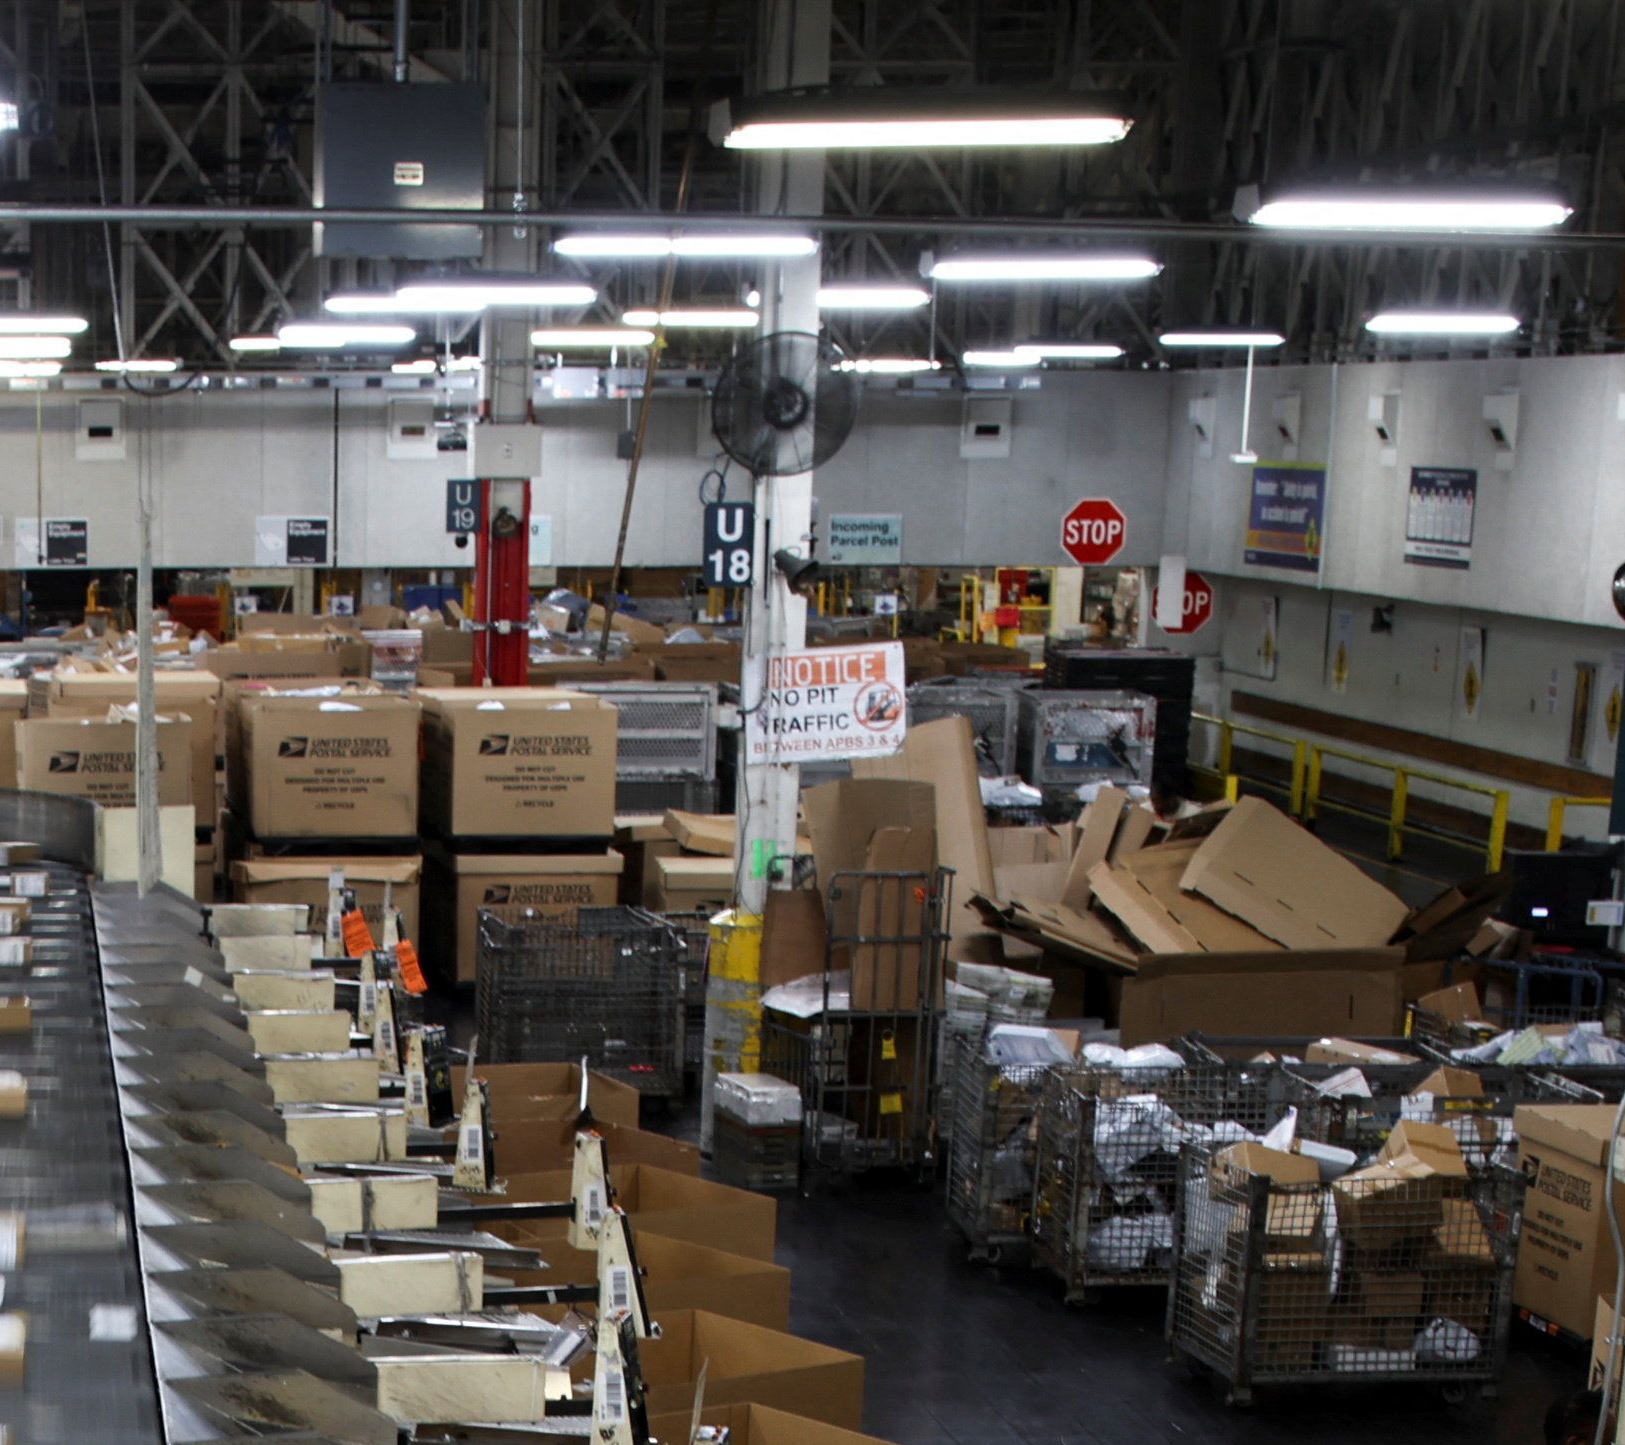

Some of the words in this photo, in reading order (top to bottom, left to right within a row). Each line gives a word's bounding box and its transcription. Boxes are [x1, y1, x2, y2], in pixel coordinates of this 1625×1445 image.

[456, 484, 471, 504] U
[452, 509, 476, 529] 19
[716, 508, 744, 542] U
[830, 521, 890, 535] Incoming
[830, 536, 869, 547] Parcel
[871, 535, 899, 547] Post
[1065, 519, 1122, 545] STOP
[708, 549, 750, 582] 18
[772, 652, 877, 688] NOTICE
[770, 688, 800, 707] NO
[806, 686, 840, 704] PIT
[761, 712, 850, 736] TRAFFIC
[311, 737, 352, 749] UNITED
[352, 737, 390, 749] STATES
[513, 735, 552, 747] UNITED
[553, 735, 590, 746] STATES
[867, 735, 877, 748] 3
[309, 749, 349, 759] POSTAL
[350, 748, 391, 758] SERVICE
[511, 746, 549, 757] POSTAL
[551, 746, 592, 757] SERVICE
